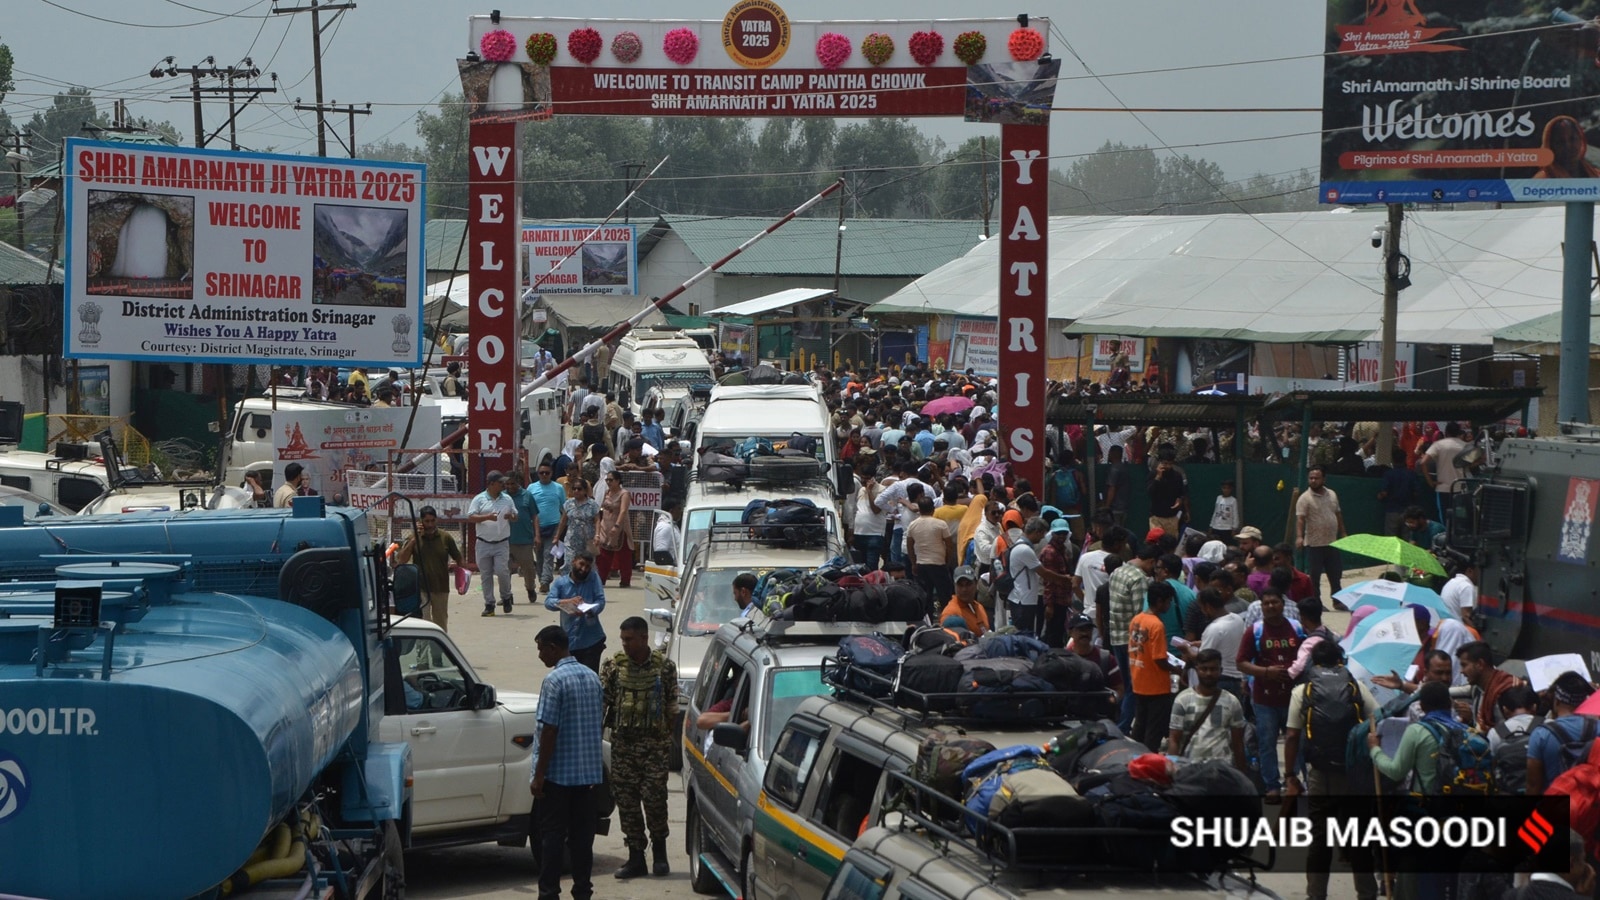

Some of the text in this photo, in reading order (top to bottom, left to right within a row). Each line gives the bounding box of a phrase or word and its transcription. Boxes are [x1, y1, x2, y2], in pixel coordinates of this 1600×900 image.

[741, 20, 772, 32] YATRA
[742, 34, 770, 47] 2025
[1344, 30, 1422, 41] Shri Amarnath Ji
[1354, 42, 1379, 51] Yatra
[593, 73, 926, 90] WELCOME TO TRANSIT CAMP PANTHA CHOWK
[1342, 75, 1571, 94] Shri Amarnath Ji Shrine Board
[651, 94, 877, 110] SHRI AMARNATH JI YATRA 2025
[1362, 99, 1535, 143] Welcomes
[1353, 151, 1538, 166] Pilgrims of Shri Amarnath Ji Yatra
[79, 150, 415, 203] SHRI AMARNATH JI YATRA 2025
[1522, 185, 1597, 198] Department
[208, 202, 301, 230] WELCOME
[522, 230, 559, 242] ARNATH
[562, 230, 570, 241] JI
[604, 228, 630, 241] 2025
[243, 239, 266, 264] TO
[535, 246, 576, 256] WELCOME
[205, 272, 301, 299] SRINAGAR
[473, 147, 511, 458] WELCOME
[1009, 150, 1041, 462] YATRIS
[122, 301, 376, 328] District Administration Srinagar
[164, 323, 337, 341] Wishes You A Happy Yatra
[140, 340, 357, 360] Courtesy: District Magistrate, Srinagar
[1266, 638, 1296, 648] DARE
